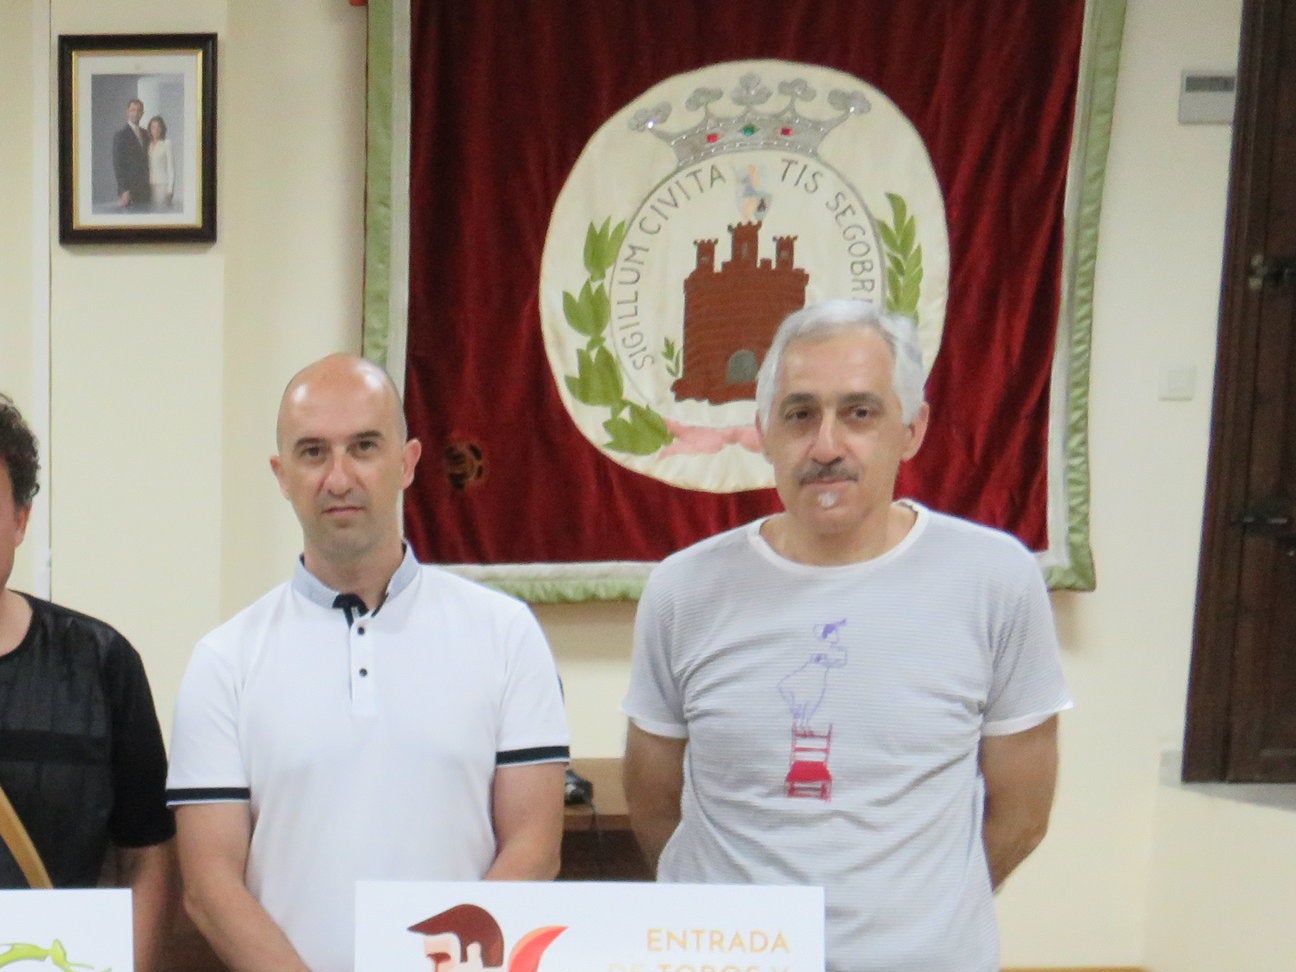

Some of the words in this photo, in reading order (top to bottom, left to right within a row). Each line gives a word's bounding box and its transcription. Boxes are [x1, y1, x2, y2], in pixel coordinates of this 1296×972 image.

[616, 244, 655, 371] SIGILLUM
[638, 163, 727, 236] CIVITA
[781, 158, 824, 194] TIS
[646, 928, 791, 953] ENTRADA
